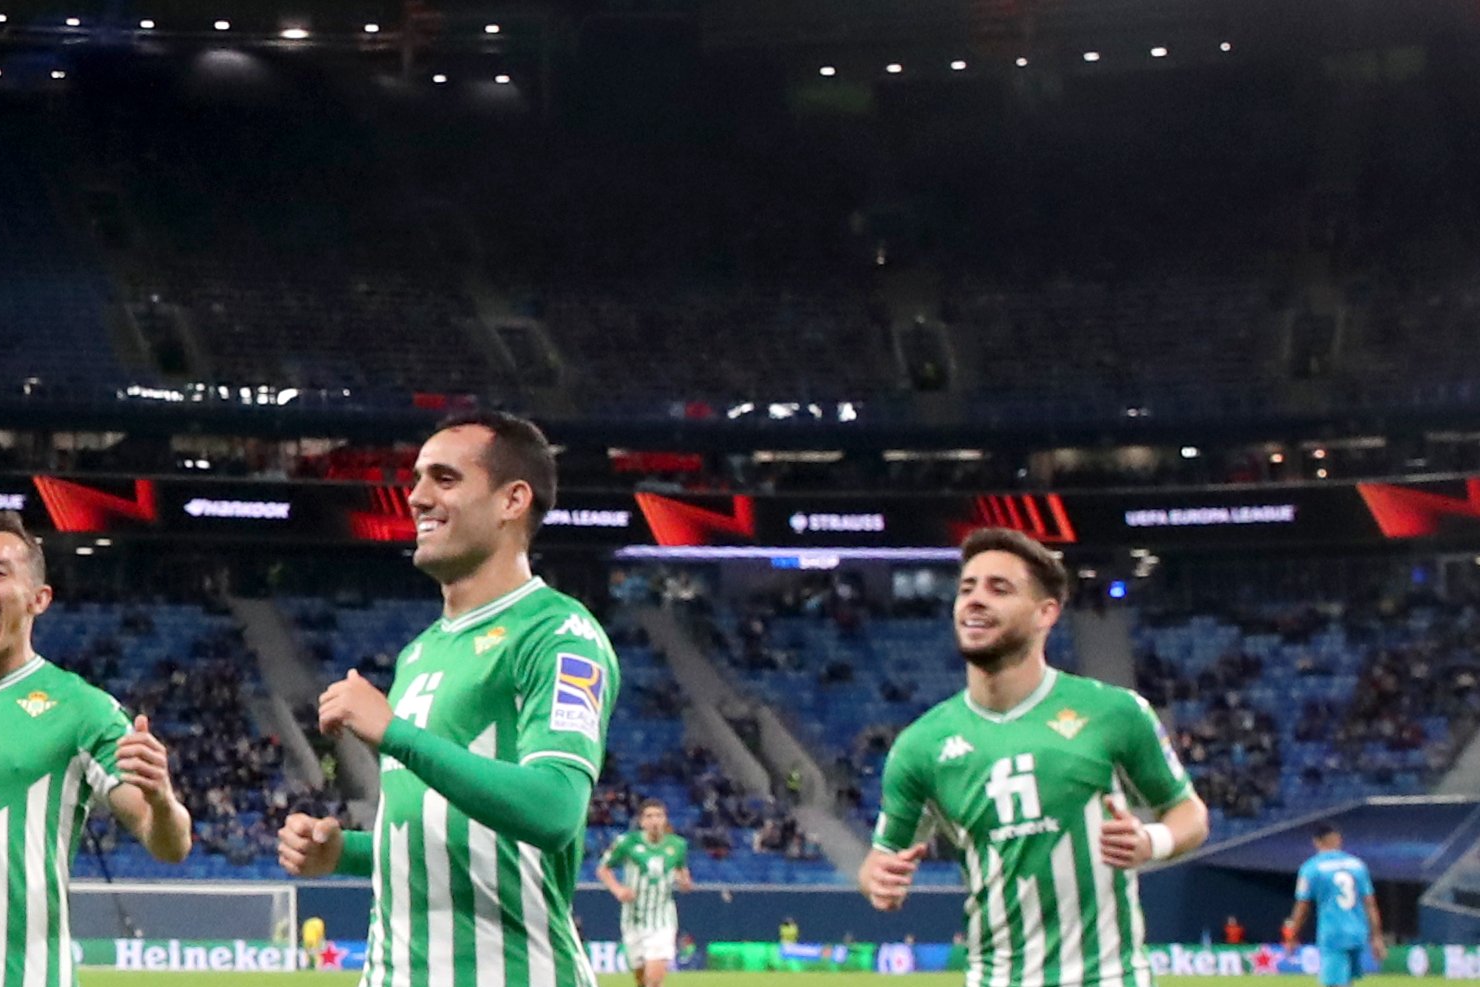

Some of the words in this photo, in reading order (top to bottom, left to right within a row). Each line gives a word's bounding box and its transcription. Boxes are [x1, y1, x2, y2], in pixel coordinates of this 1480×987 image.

[572, 510, 629, 527] LEAGUE
[808, 513, 885, 532] STRAUSS
[1125, 509, 1168, 527] UEFA
[1168, 507, 1230, 526] EUROPA
[1230, 504, 1295, 523] LEAGUE
[985, 752, 1041, 823] fi
[1332, 871, 1357, 911] 3
[115, 938, 308, 970] Heineken
[1149, 943, 1243, 976] eken
